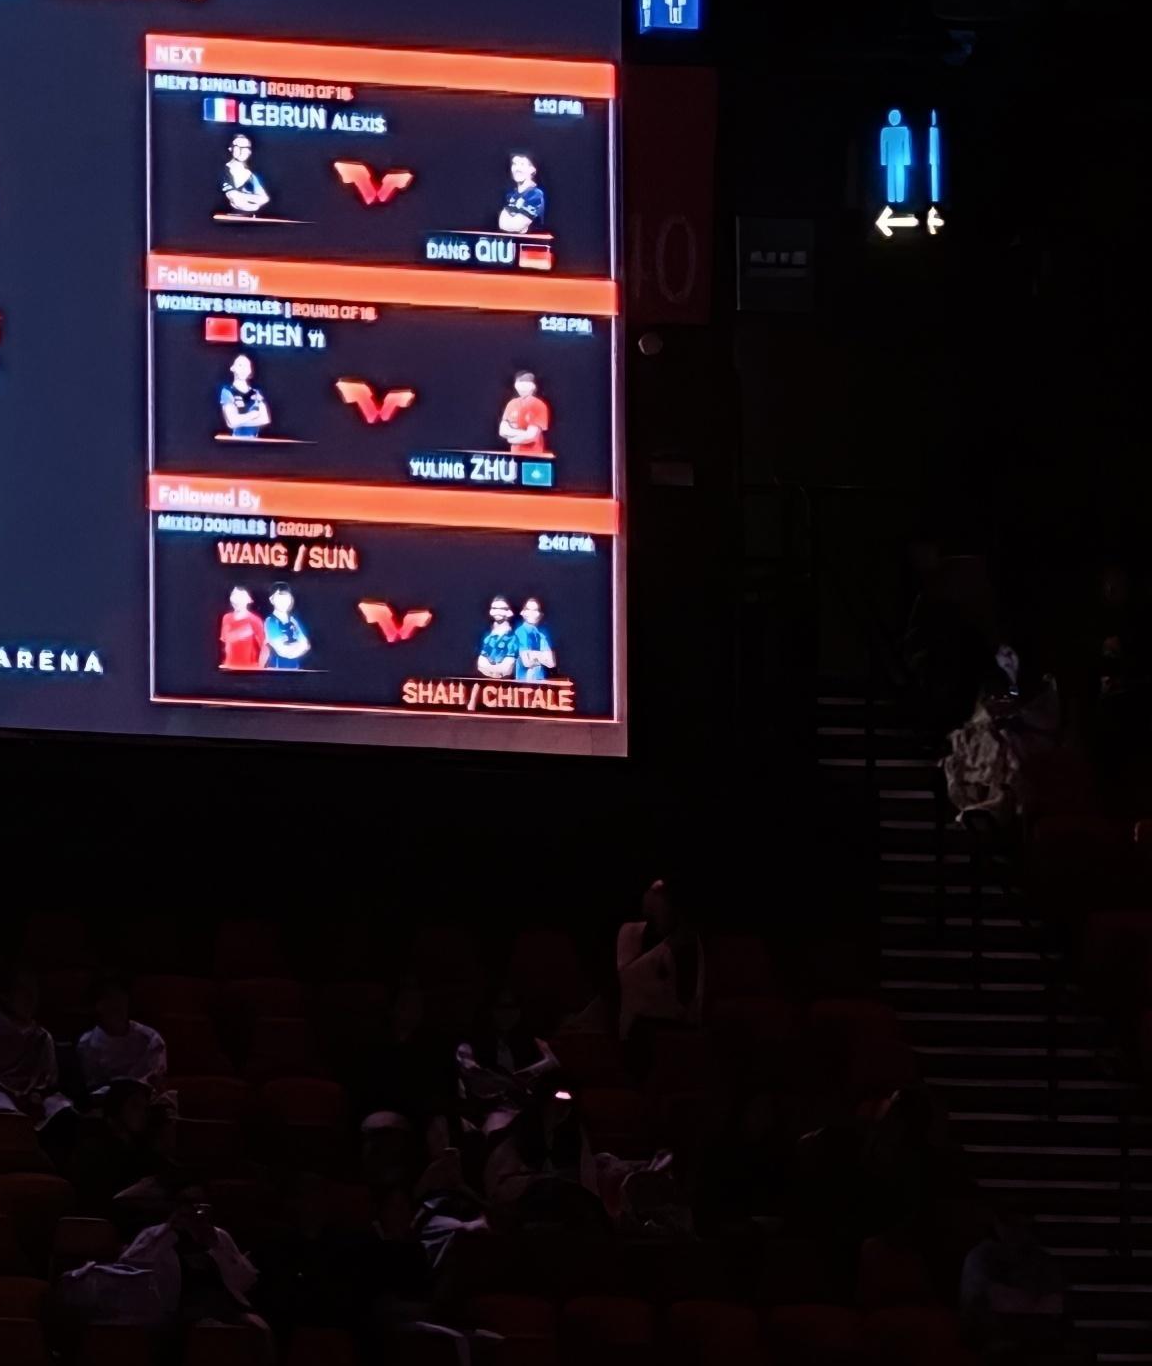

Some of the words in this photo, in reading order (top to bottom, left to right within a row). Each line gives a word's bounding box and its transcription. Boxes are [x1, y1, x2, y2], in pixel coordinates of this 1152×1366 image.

[155, 46, 205, 64] NEXT
[200, 77, 258, 94] SINGLES
[267, 82, 314, 98] ROUND
[316, 85, 334, 99] OF
[239, 103, 326, 130] LEBRUN
[331, 115, 387, 133] ALEXIS
[426, 240, 471, 261] DANG
[475, 237, 516, 264] QIU
[157, 266, 232, 287] Followed
[238, 270, 260, 291] By
[224, 298, 282, 315] SINGLES
[292, 303, 338, 318] ROUND
[340, 306, 359, 319] OF
[240, 321, 303, 347] CHEN
[409, 457, 465, 480] YULING
[470, 455, 518, 482] ZHU
[158, 486, 233, 506] Followed
[239, 490, 260, 510] By
[158, 514, 202, 532] MIXED
[203, 517, 267, 535] DOUBLES
[277, 522, 324, 537] GROUP
[218, 541, 288, 567] WANG
[309, 546, 358, 570] SUN
[402, 680, 465, 705] SHAH
[482, 685, 575, 712] CHITALE
